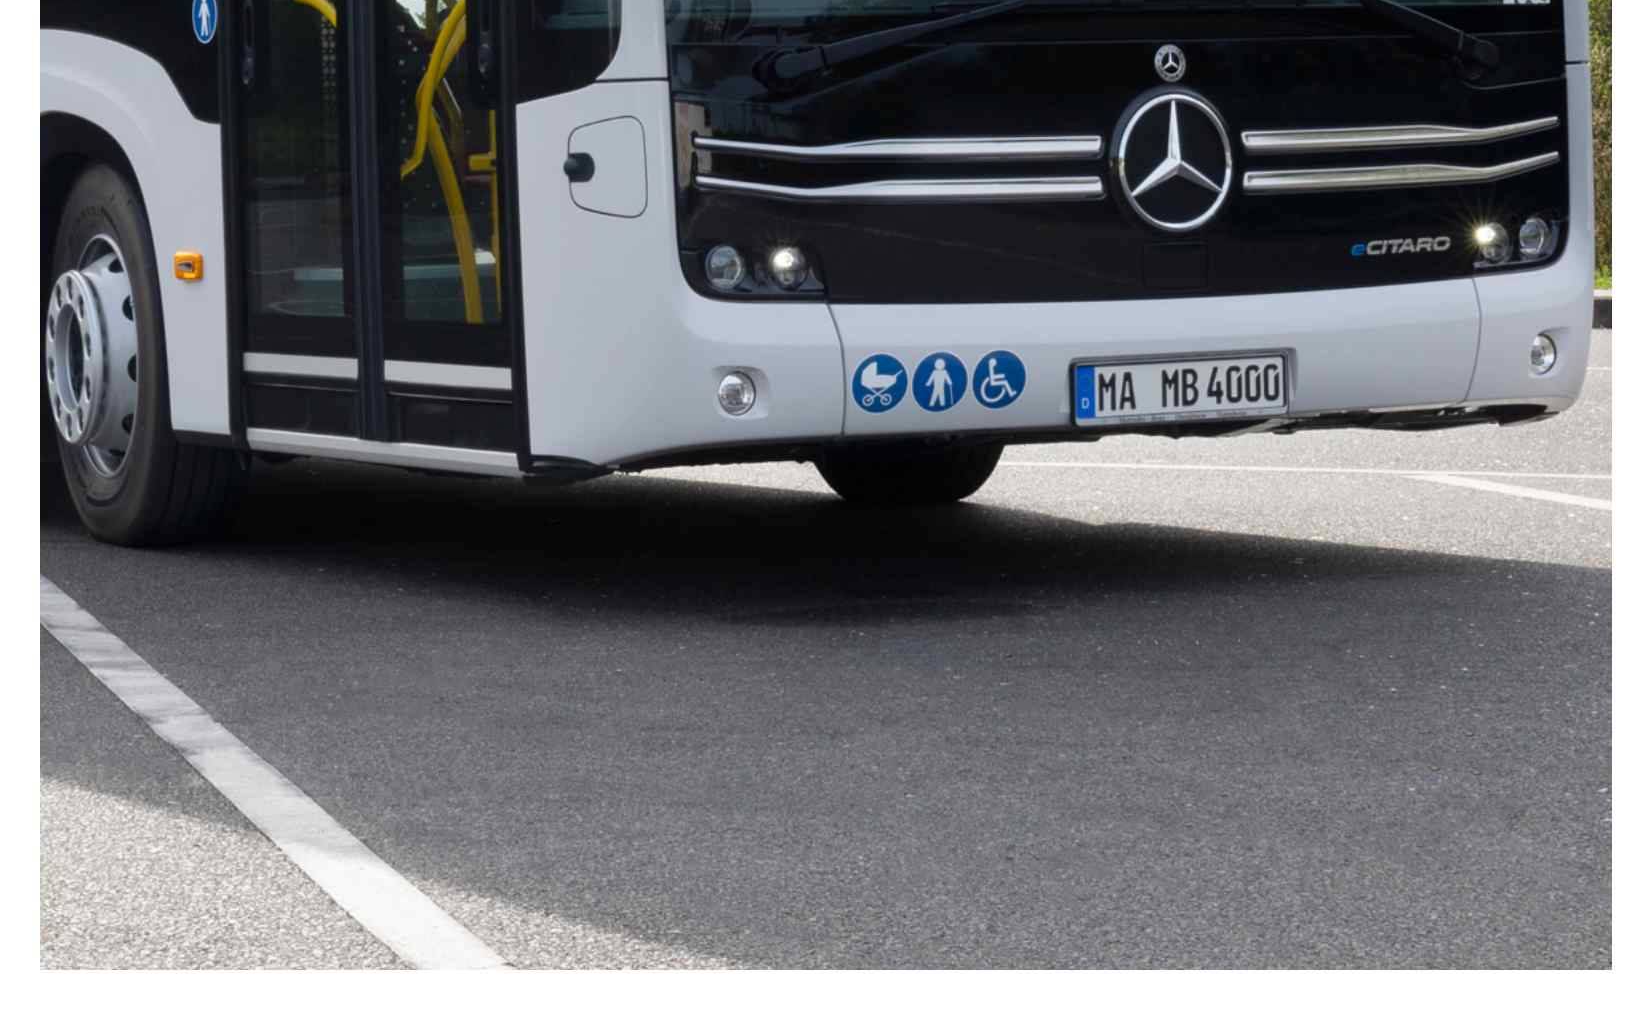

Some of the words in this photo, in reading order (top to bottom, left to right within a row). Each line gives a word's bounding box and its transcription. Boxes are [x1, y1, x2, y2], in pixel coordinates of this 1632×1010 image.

[1351, 236, 1451, 257] eCITARO
[1098, 371, 1136, 411] MA
[1161, 368, 1199, 408] MB
[1206, 363, 1280, 404] 4000
